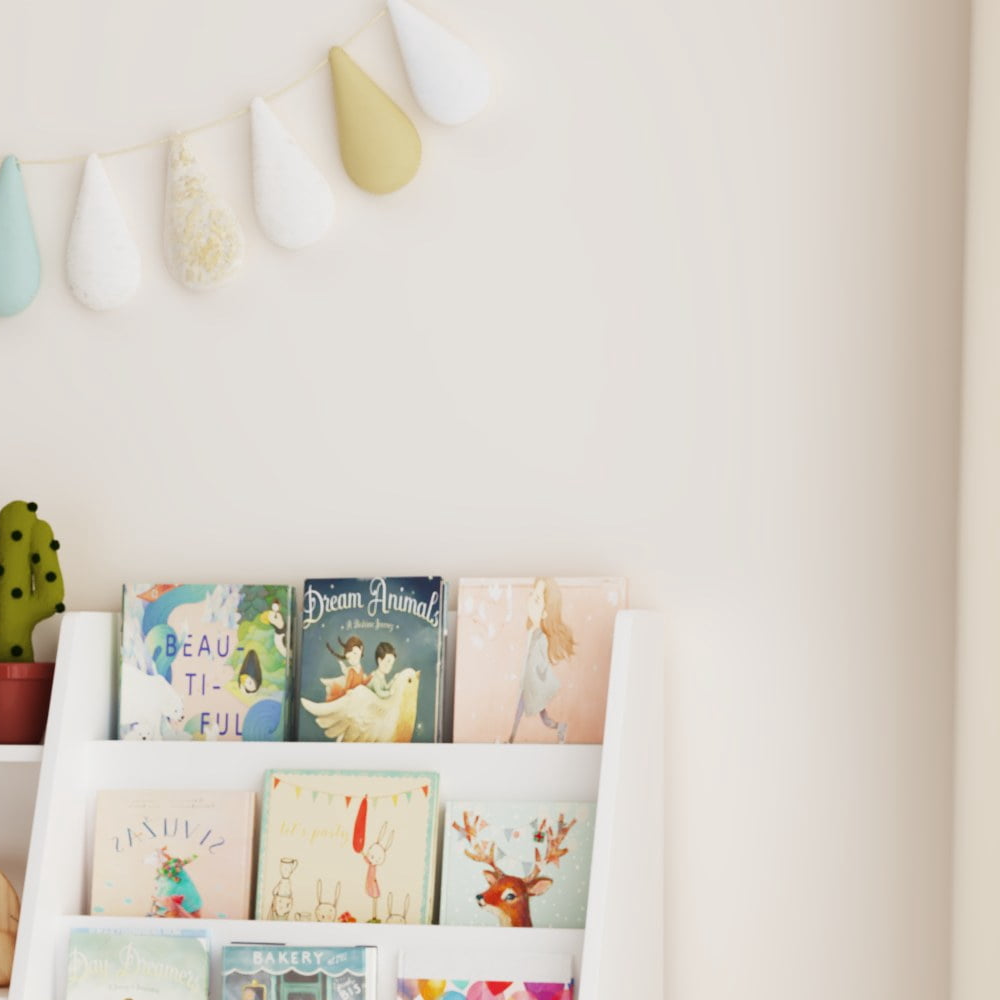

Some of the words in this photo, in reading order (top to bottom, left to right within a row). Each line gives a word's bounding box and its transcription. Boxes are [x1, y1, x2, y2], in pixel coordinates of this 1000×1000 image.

[303, 584, 365, 630] Dream
[367, 576, 440, 628] Animals
[165, 633, 245, 657] BEAU-
[185, 672, 222, 696] TI-
[200, 711, 244, 737] FUL
[252, 950, 325, 966] BAKERY
